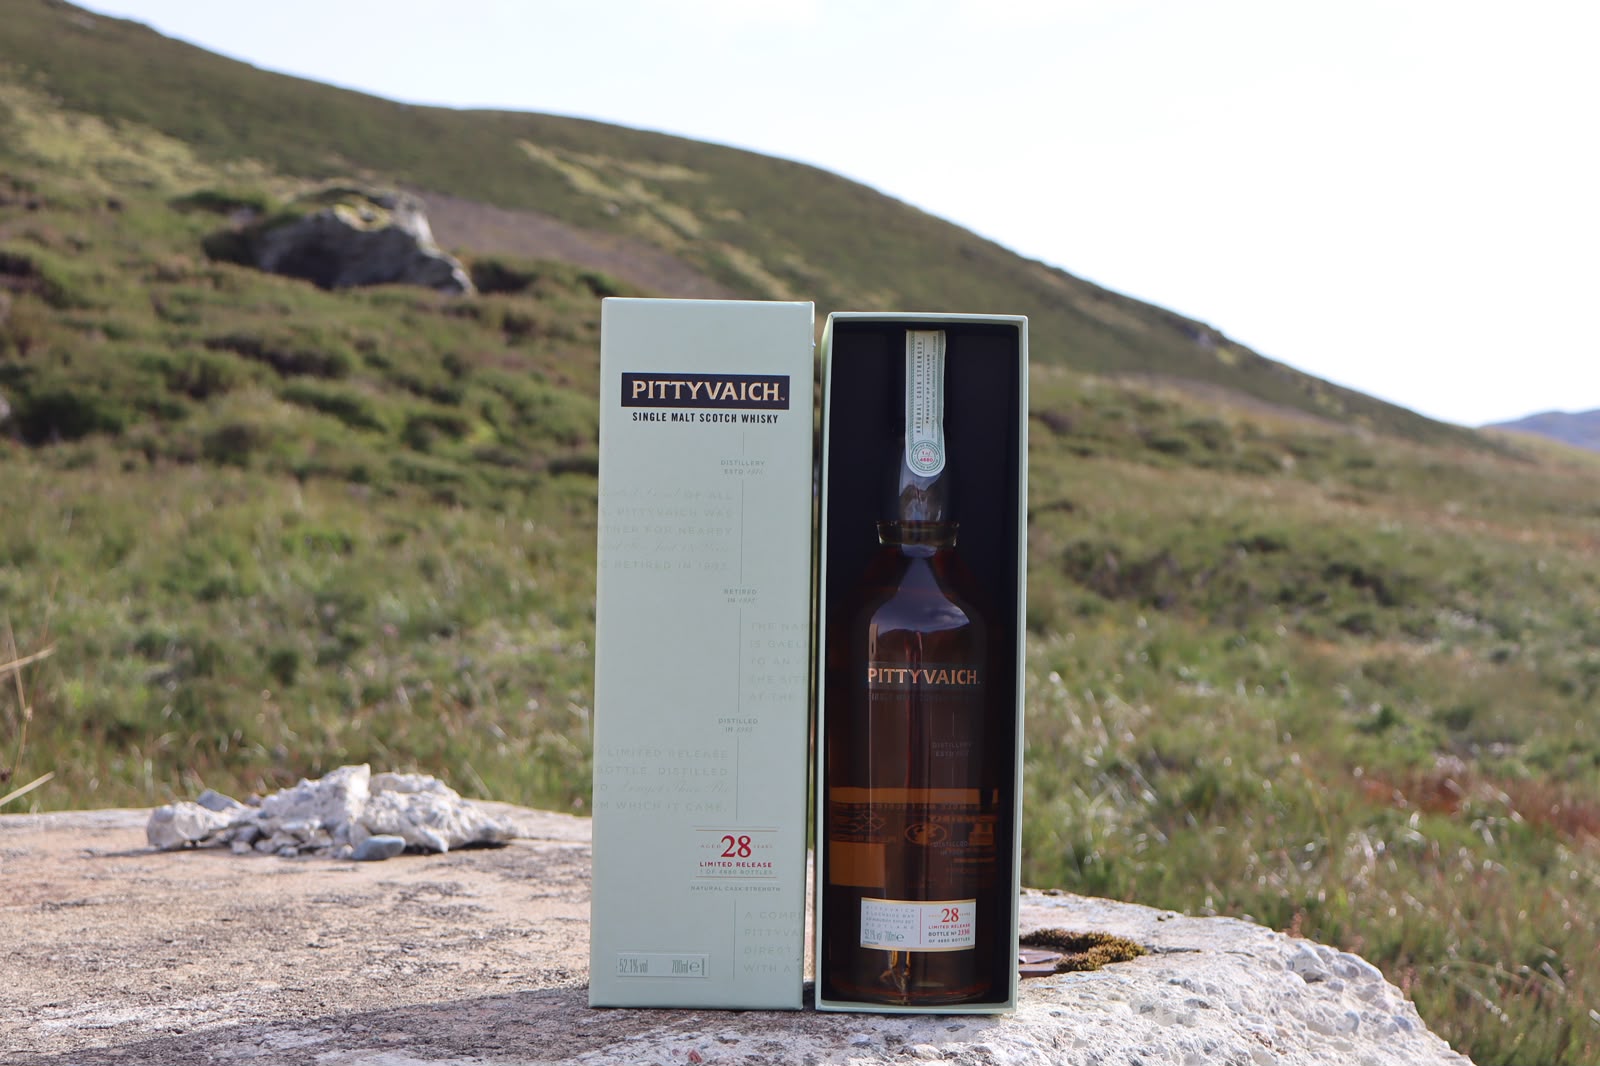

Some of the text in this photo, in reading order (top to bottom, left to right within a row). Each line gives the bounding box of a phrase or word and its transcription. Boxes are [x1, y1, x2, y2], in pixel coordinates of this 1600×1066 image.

[631, 380, 780, 401] PITTYVAICH
[632, 412, 779, 424] SINGLE MALT SCOTCH WHISKY
[868, 667, 977, 685] PITTYVAICH
[658, 767, 729, 776] DISTILLED
[720, 834, 752, 858] 28
[941, 907, 959, 923] 28
[619, 958, 638, 973] 52.1%
[672, 959, 689, 973] 700ml
